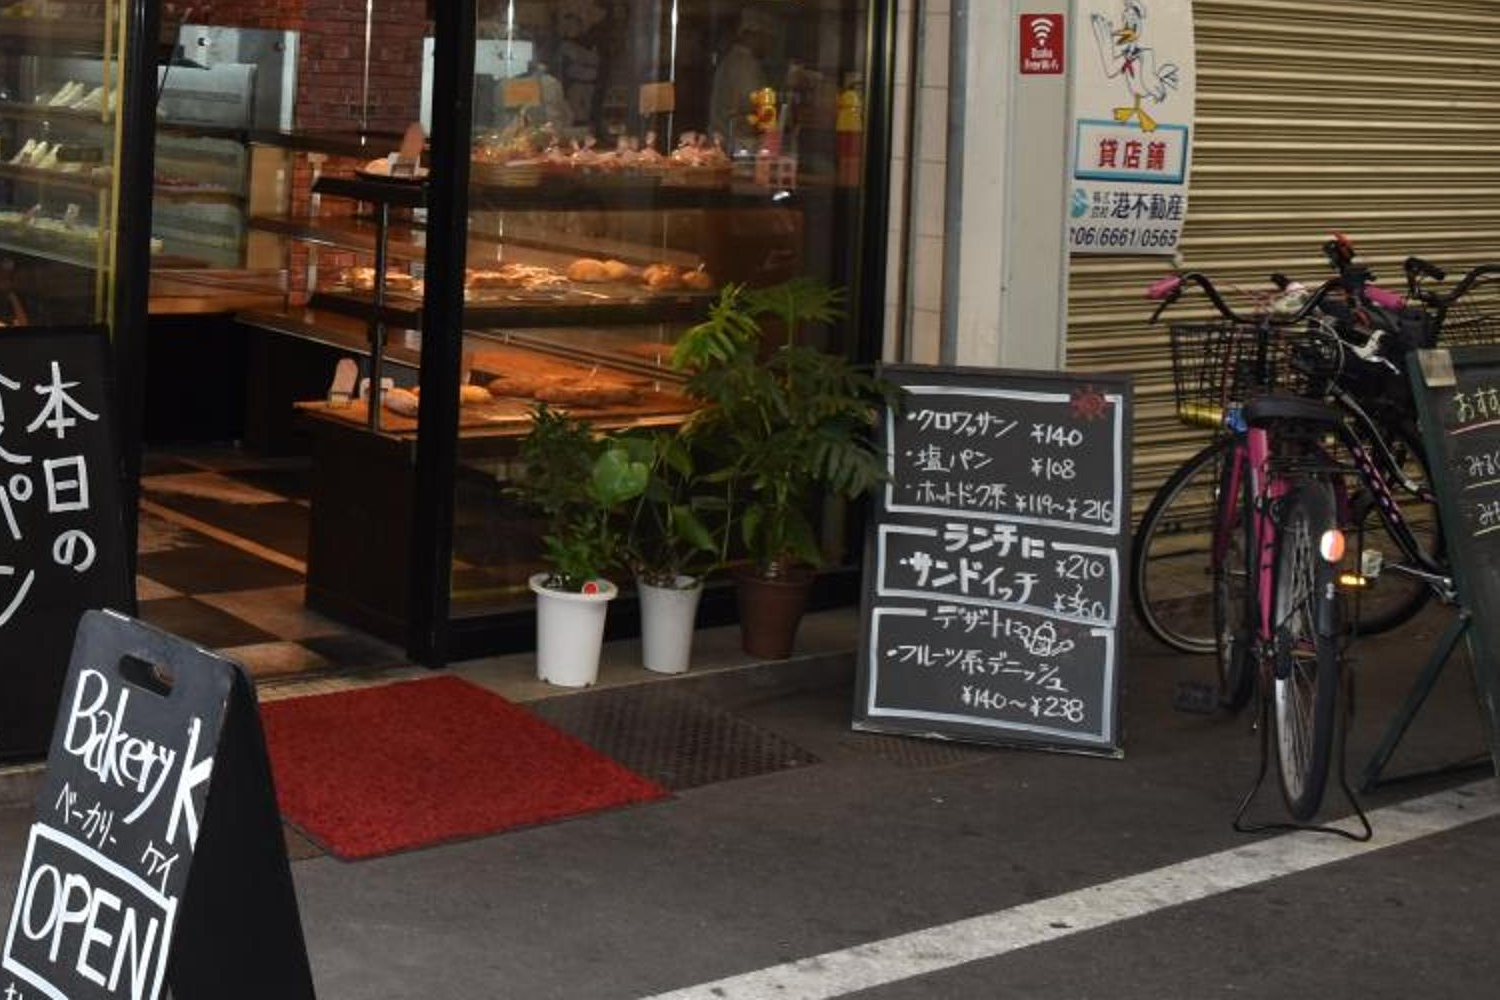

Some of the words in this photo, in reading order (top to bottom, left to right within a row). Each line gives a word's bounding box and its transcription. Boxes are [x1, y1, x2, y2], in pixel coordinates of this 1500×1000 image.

[1098, 139, 1167, 170] 貸店舗
[1110, 191, 1182, 221] 港不動産
[26, 361, 100, 573] 本日の
[943, 522, 1046, 559] ランチに
[63, 668, 176, 825] Bakery
[55, 781, 117, 848] ベーカリー
[141, 840, 179, 898] ケイ
[21, 863, 160, 1000] OPEN
